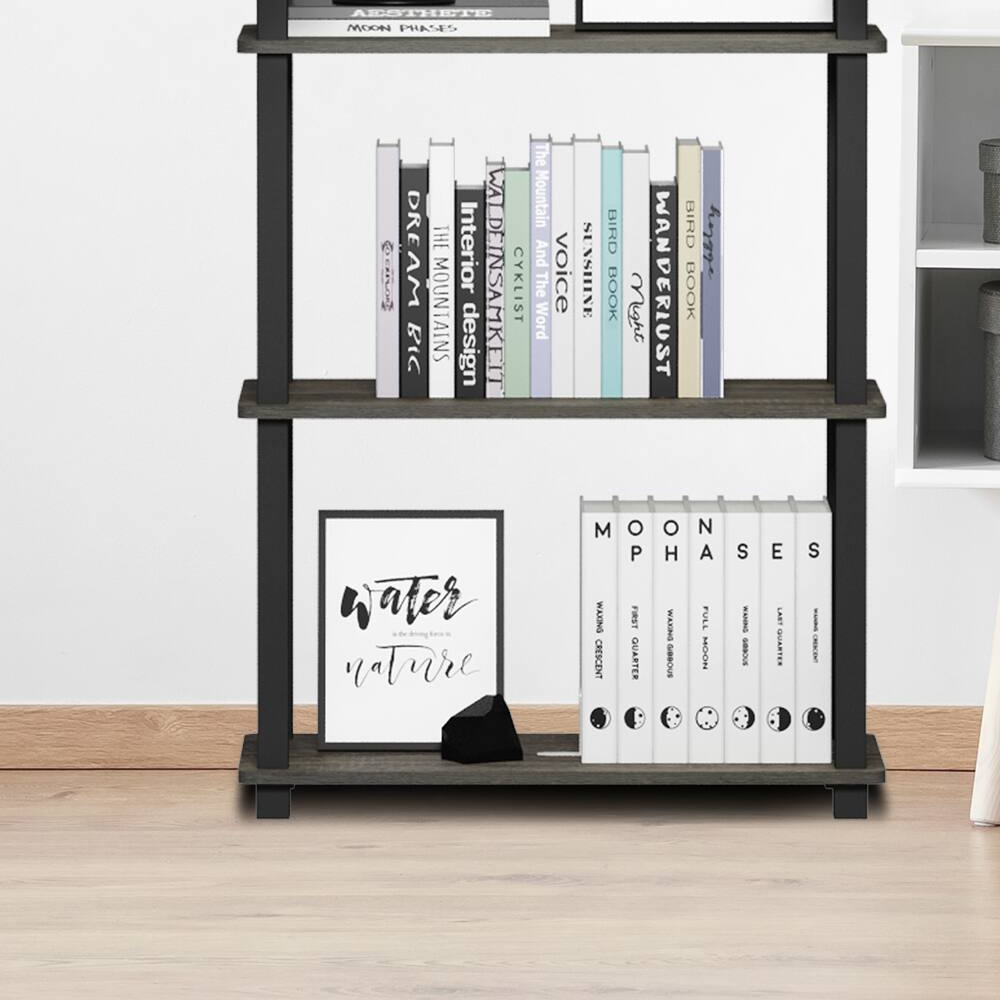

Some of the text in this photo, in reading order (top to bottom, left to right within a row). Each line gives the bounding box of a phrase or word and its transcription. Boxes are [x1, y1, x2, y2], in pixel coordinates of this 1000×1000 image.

[347, 23, 458, 33] MOON PHASES
[406, 190, 422, 375] DREAM BIG
[487, 167, 505, 390] WALDEINSAMKEIT
[535, 143, 550, 340] The Mountain And The Word
[555, 232, 572, 314] voice
[583, 222, 593, 319] SUNSHINE
[608, 209, 618, 322] BIRD BOOK
[686, 200, 696, 321] BIRD BOOK
[433, 225, 450, 363] THE MOUNTAINS
[459, 201, 480, 387] Interior design
[513, 246, 524, 323] CYKLIST
[627, 272, 645, 343] Night
[655, 190, 672, 377] WANDERLUST
[594, 517, 713, 539] MOON
[631, 542, 820, 562] PHASES
[340, 575, 478, 630] water
[595, 601, 604, 680] WAXING CRESCENT
[631, 605, 639, 680] FIRST QUARTER
[346, 644, 480, 688] nature
